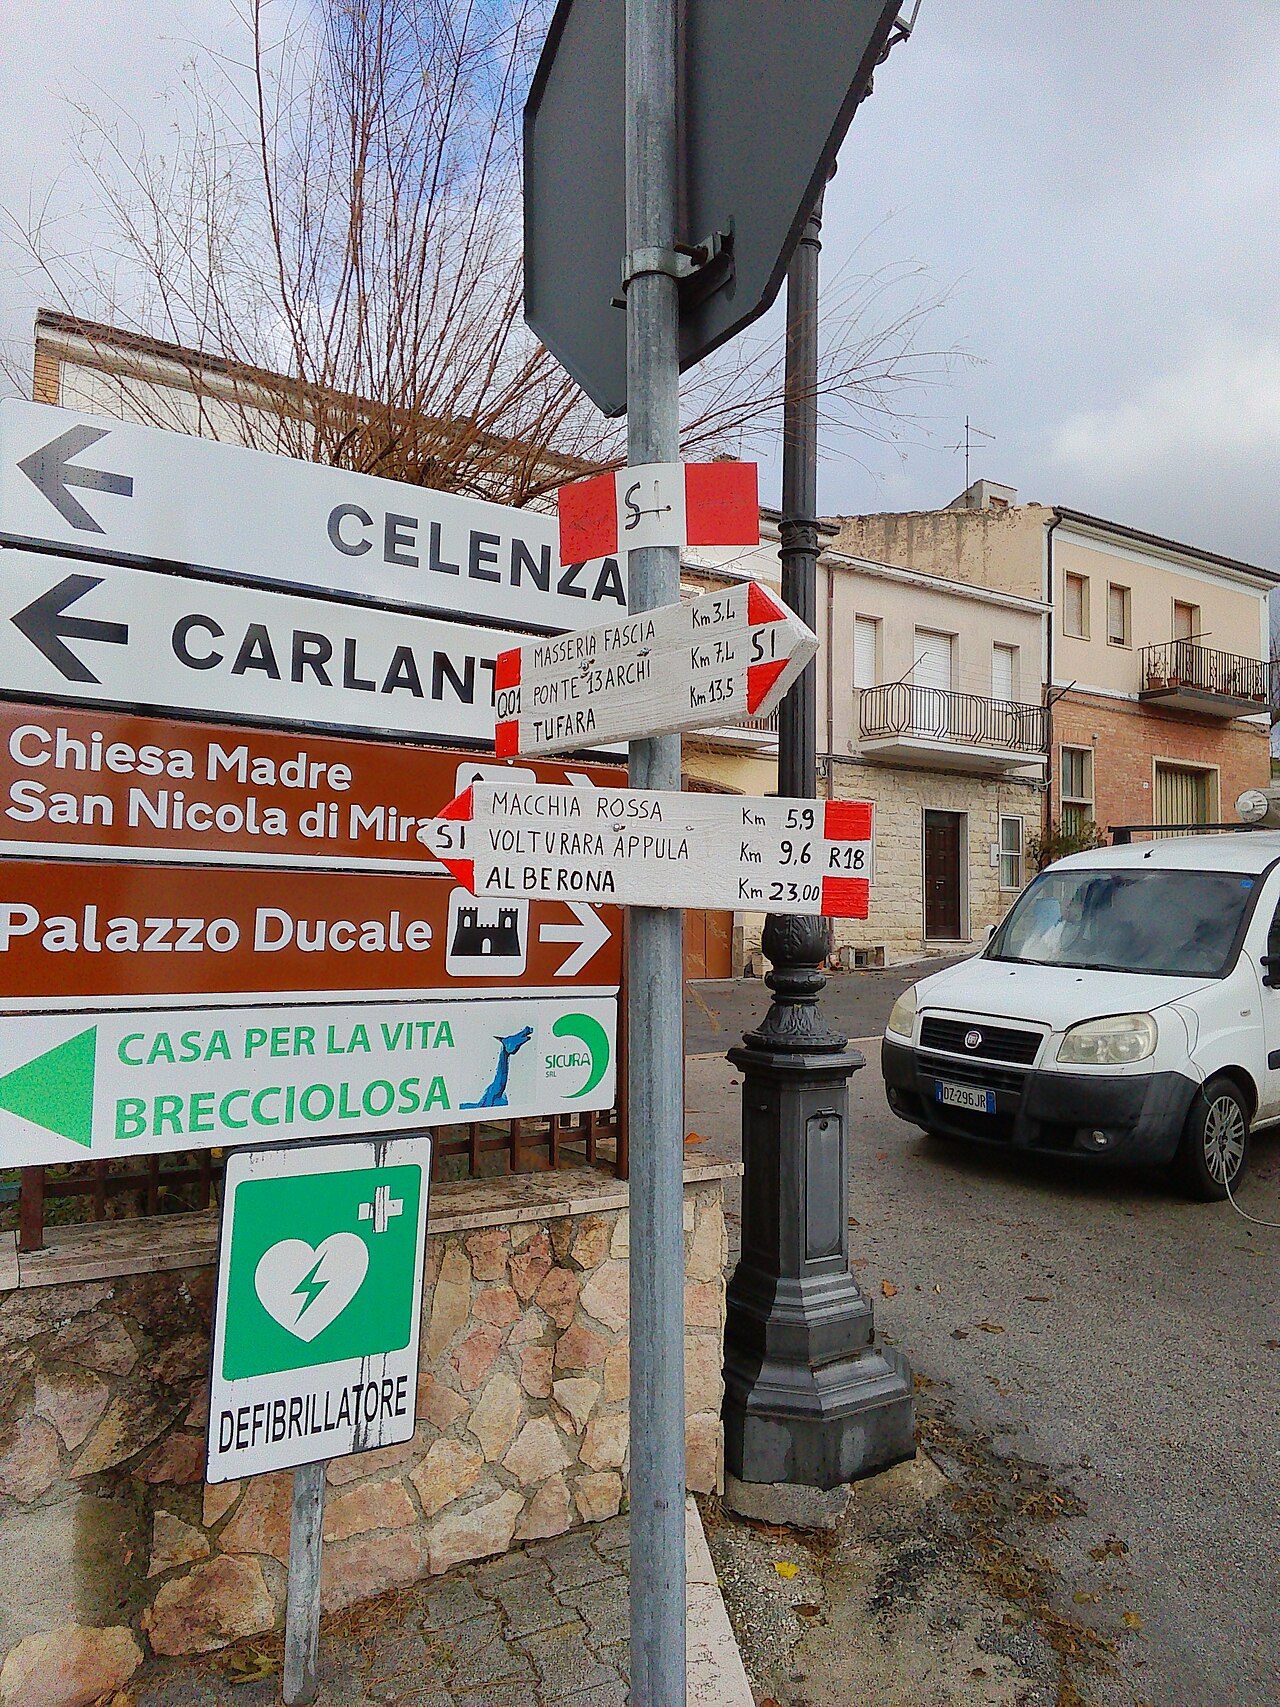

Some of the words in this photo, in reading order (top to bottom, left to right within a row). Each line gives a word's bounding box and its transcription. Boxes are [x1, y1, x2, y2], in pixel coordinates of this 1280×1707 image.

[327, 503, 626, 607] CELENZA
[534, 634, 597, 669] MASSERIA
[604, 619, 656, 651] FASCIA
[692, 607, 710, 629] Km
[497, 687, 522, 719] Q01
[533, 676, 580, 706] PONTE
[691, 646, 710, 669] Km
[533, 708, 596, 743] TUFARA
[690, 685, 707, 708] Km
[708, 677, 734, 703] 13,5
[8, 723, 195, 779] Chiesa
[207, 743, 353, 791] Madre
[4, 779, 113, 828] San
[127, 788, 288, 837] Nicola
[298, 801, 340, 840] di
[349, 803, 431, 842] Mir
[492, 792, 582, 817] MACCHIA
[597, 796, 663, 822] ROSSA
[742, 807, 767, 827] Km
[785, 808, 815, 832] 5,9
[489, 828, 604, 857] VOLTURARA
[613, 835, 689, 861] APPULA
[739, 846, 763, 864] Km
[779, 840, 812, 867] 9,6
[829, 847, 866, 871] R18
[486, 866, 616, 893] ALBERONA
[738, 878, 764, 900] Km
[768, 882, 821, 903] 23,00
[0, 903, 241, 954] Palazzo
[254, 907, 433, 953] Ducale
[117, 1028, 232, 1067] CASA
[244, 1026, 319, 1059] PER
[327, 1023, 373, 1054] LA
[380, 1020, 456, 1051] VITA
[545, 1052, 591, 1070] SICURA
[545, 1070, 557, 1079] SRL
[114, 1076, 452, 1141] BRECCIOLOSA
[218, 1374, 409, 1454] DEFIBRILLATORE
